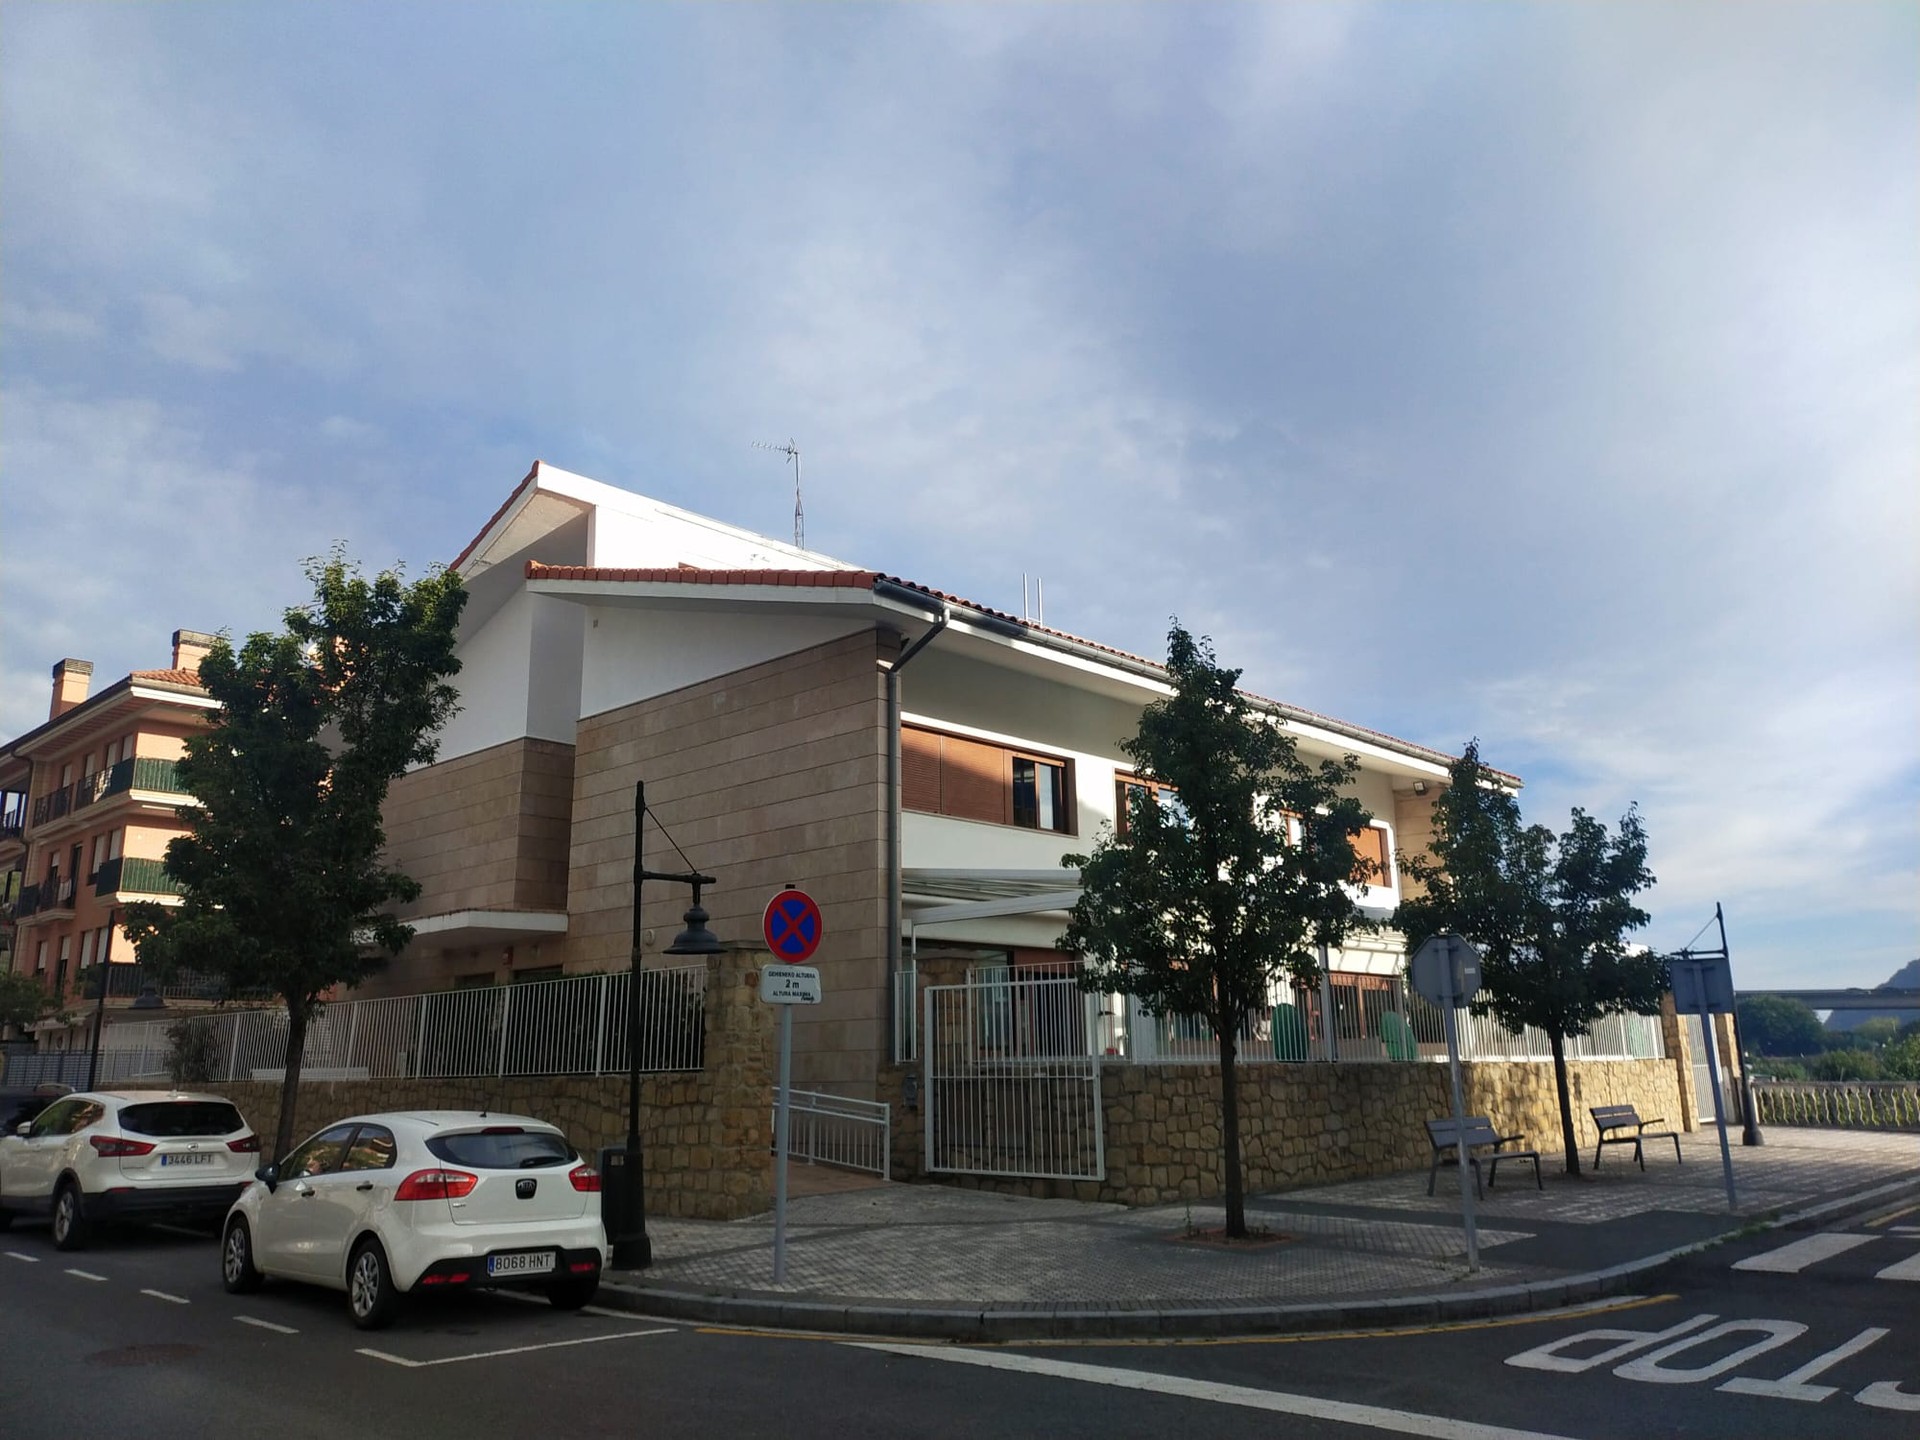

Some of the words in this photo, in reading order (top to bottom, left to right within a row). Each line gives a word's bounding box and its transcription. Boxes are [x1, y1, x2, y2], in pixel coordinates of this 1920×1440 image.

[785, 979, 791, 988] 2
[792, 981, 799, 989] m
[495, 1256, 526, 1270] 8068
[529, 1254, 551, 1268] HNT
[1503, 1313, 1920, 1411] TOP
